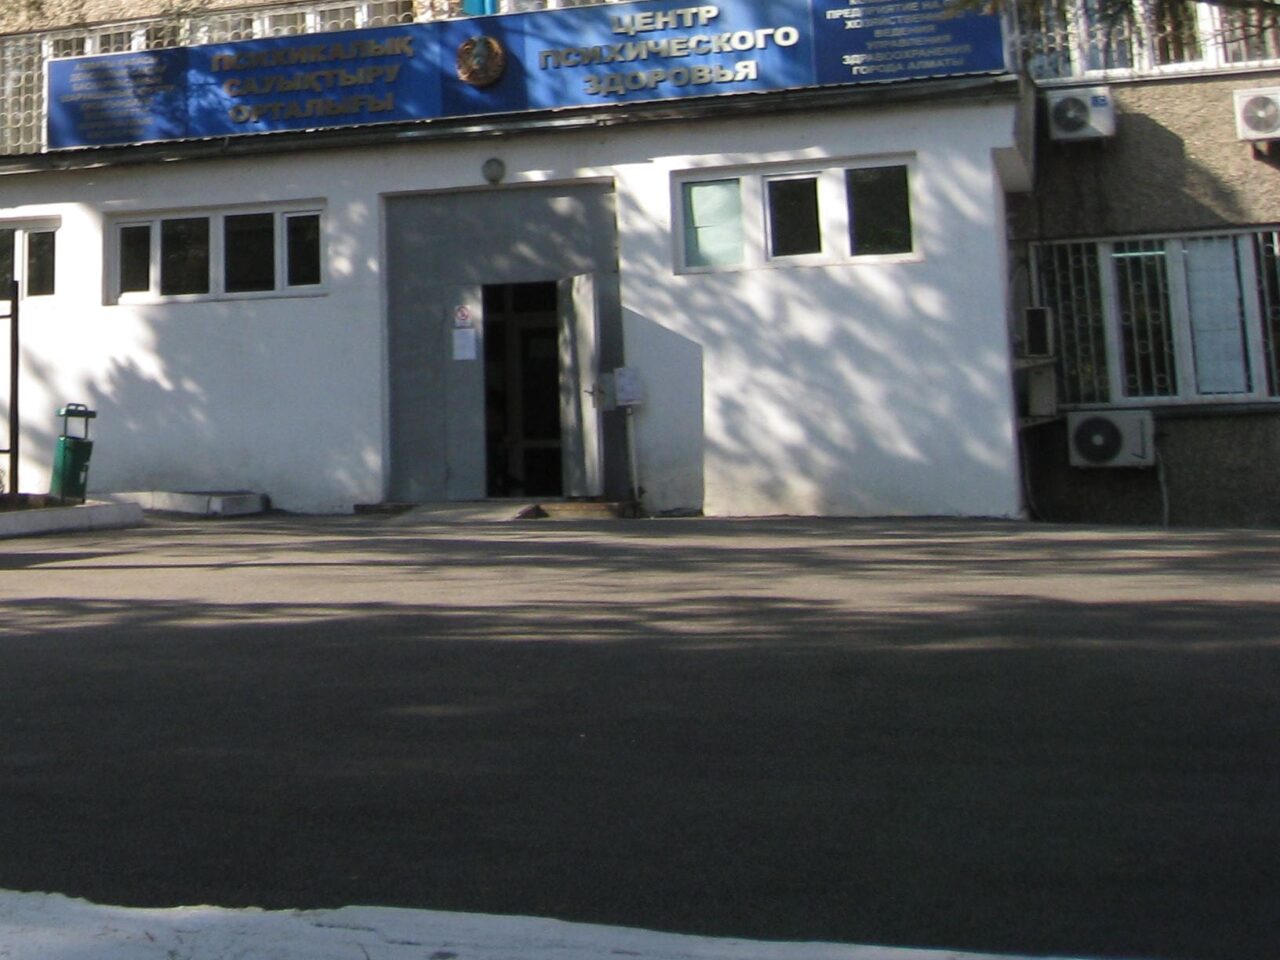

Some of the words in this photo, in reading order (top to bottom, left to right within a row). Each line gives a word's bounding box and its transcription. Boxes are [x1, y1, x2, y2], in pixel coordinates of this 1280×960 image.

[611, 5, 720, 35] ЦЕНТР
[538, 25, 800, 69] ПСИХИЧЕСКОГО
[583, 60, 759, 97] ЗДОРОВЬЯ
